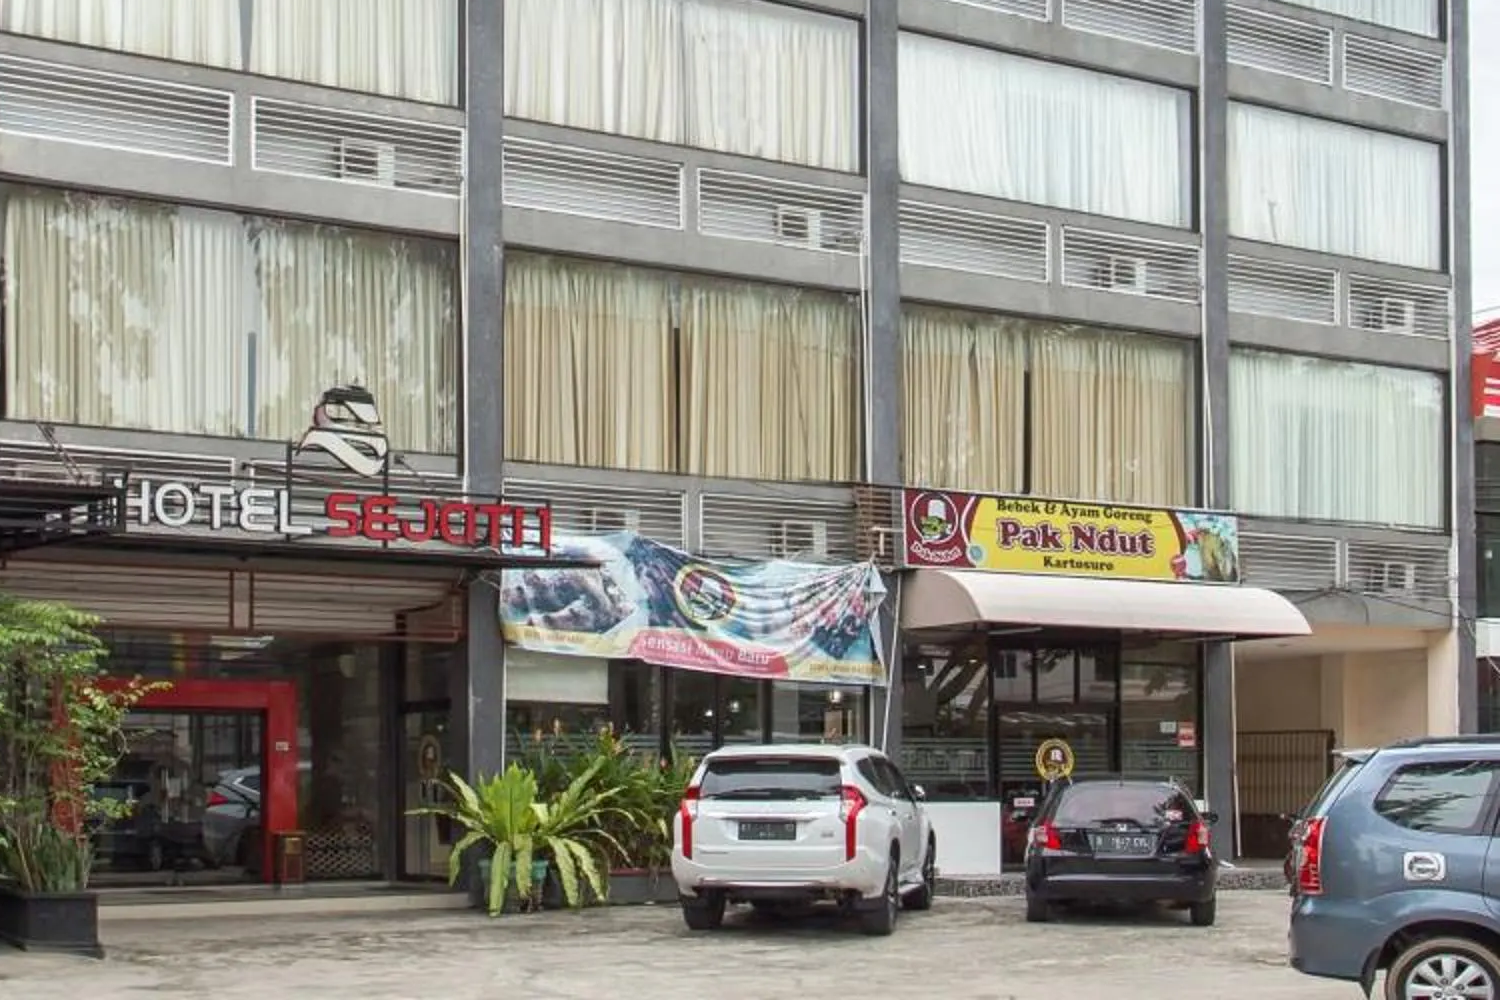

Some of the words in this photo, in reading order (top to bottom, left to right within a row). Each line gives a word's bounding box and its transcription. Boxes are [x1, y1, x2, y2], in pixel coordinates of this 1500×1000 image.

[997, 499, 1041, 515] Bebek
[1060, 504, 1100, 519] Ayam
[1103, 507, 1153, 524] Goreng
[998, 519, 1065, 551] Pak
[1070, 524, 1155, 556] Ndut
